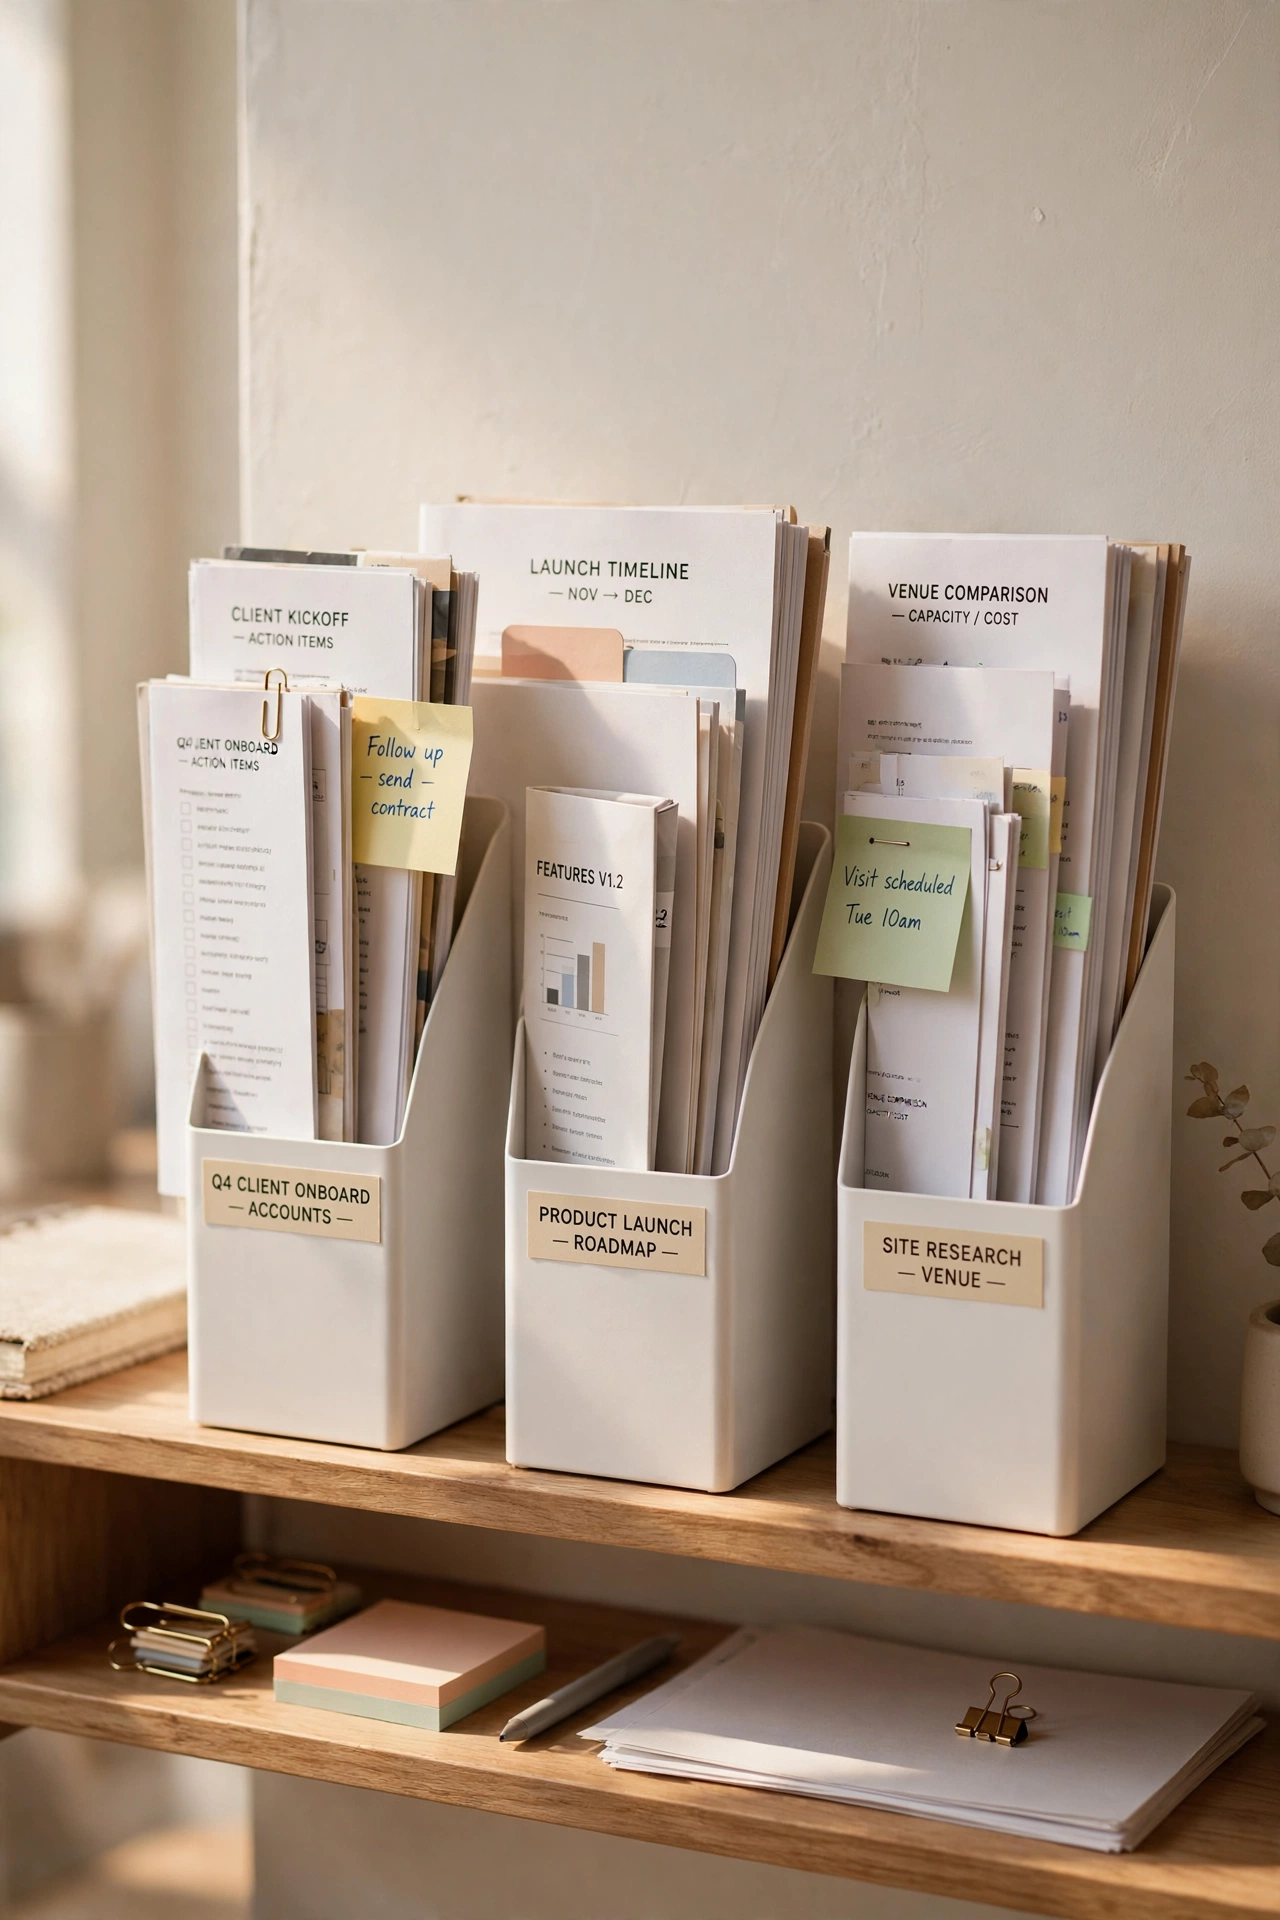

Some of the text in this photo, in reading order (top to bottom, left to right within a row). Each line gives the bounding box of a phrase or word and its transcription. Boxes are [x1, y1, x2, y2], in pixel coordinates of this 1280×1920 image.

[530, 559, 690, 580] LAUNCH TIMELINE
[568, 587, 653, 604] NOV DEC
[888, 583, 1049, 603] VENUE COMPARISON
[231, 606, 350, 628] CLIENT KICKOFF
[908, 609, 971, 625] CAPACITY
[984, 611, 1019, 626] COST
[248, 632, 335, 649] ACTION ITEMS
[224, 739, 279, 755] ONBOARD
[367, 735, 444, 769] Follow up
[191, 756, 260, 772] ACTION ITEMS
[378, 768, 414, 789] send
[371, 798, 436, 820] contract
[536, 860, 624, 890] FEATURES V1.2
[845, 865, 956, 896] Visit scheduled
[845, 903, 922, 931] Tue 10am
[211, 1173, 371, 1205] Q4 CLIENT ONBOARD
[248, 1201, 332, 1225] ACCOUNTS
[539, 1206, 692, 1237] PRODUCT LAUNCH
[574, 1234, 657, 1258] ROADMAP
[882, 1237, 1022, 1267] SITE RESEARCH
[921, 1266, 981, 1288] VENUE
